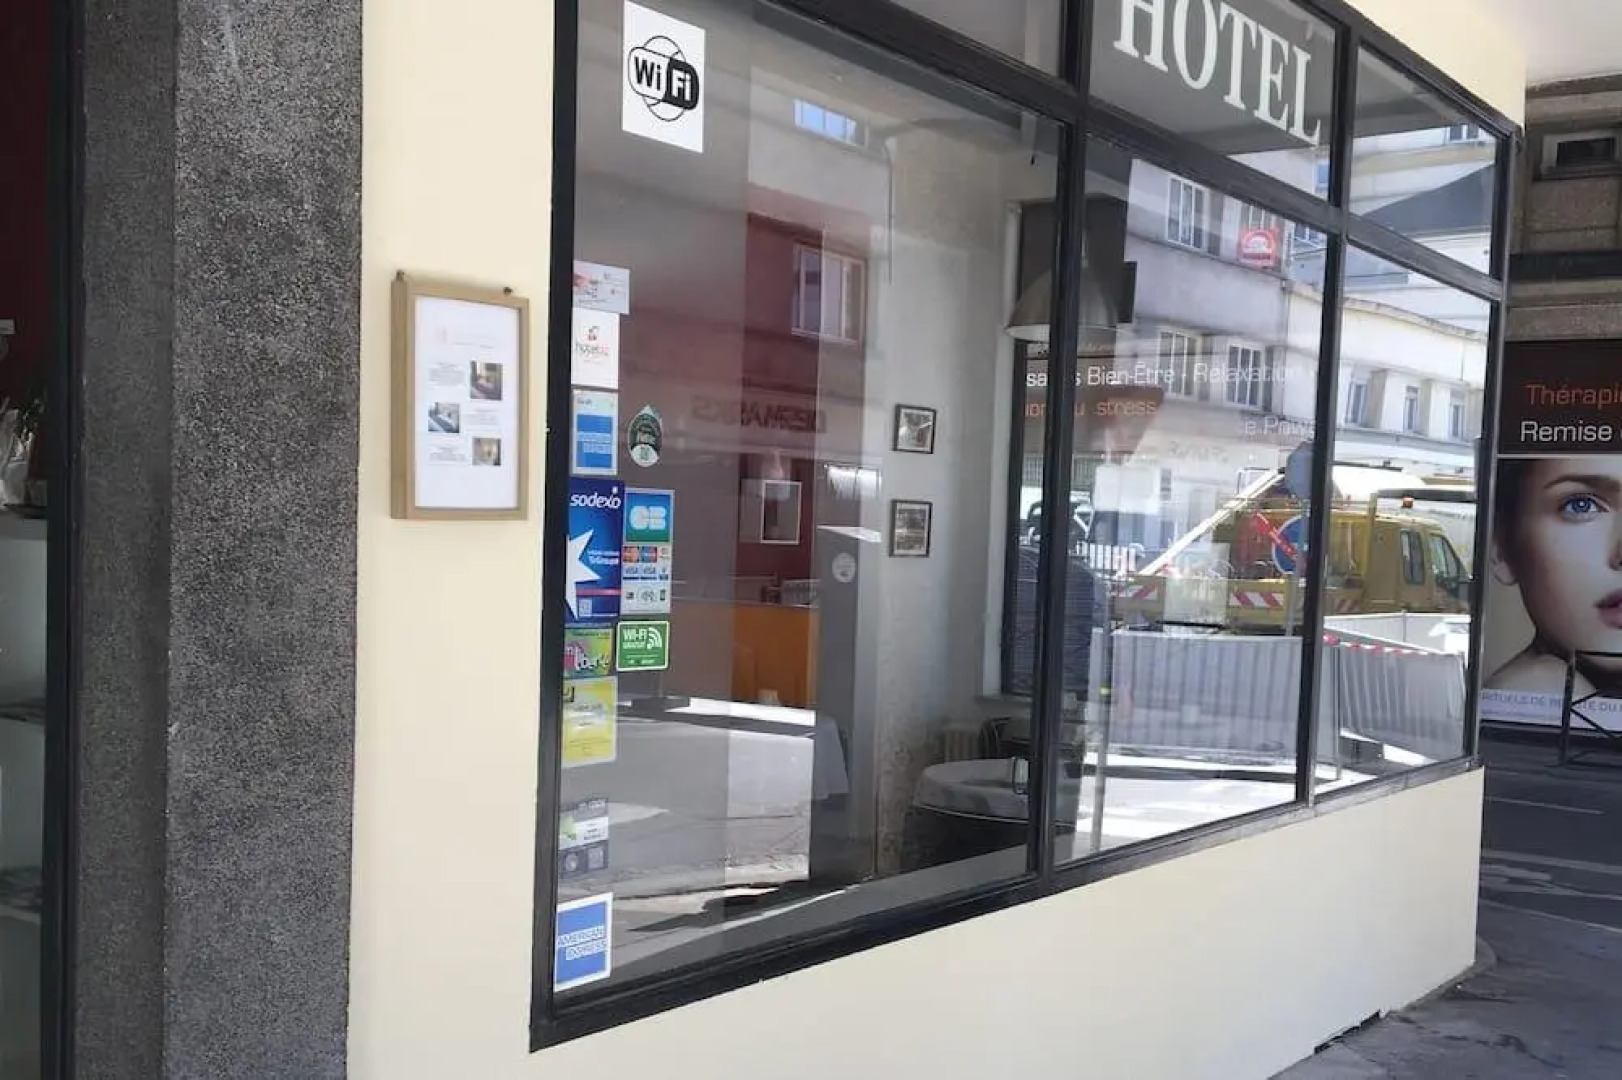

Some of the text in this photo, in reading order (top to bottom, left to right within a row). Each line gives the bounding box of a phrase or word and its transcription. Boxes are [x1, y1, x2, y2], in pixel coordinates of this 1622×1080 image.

[1113, 0, 1321, 146] HOTEL
[1524, 383, 1622, 411] Thérapi
[1520, 420, 1613, 442] Remise
[570, 488, 621, 509] sodexo
